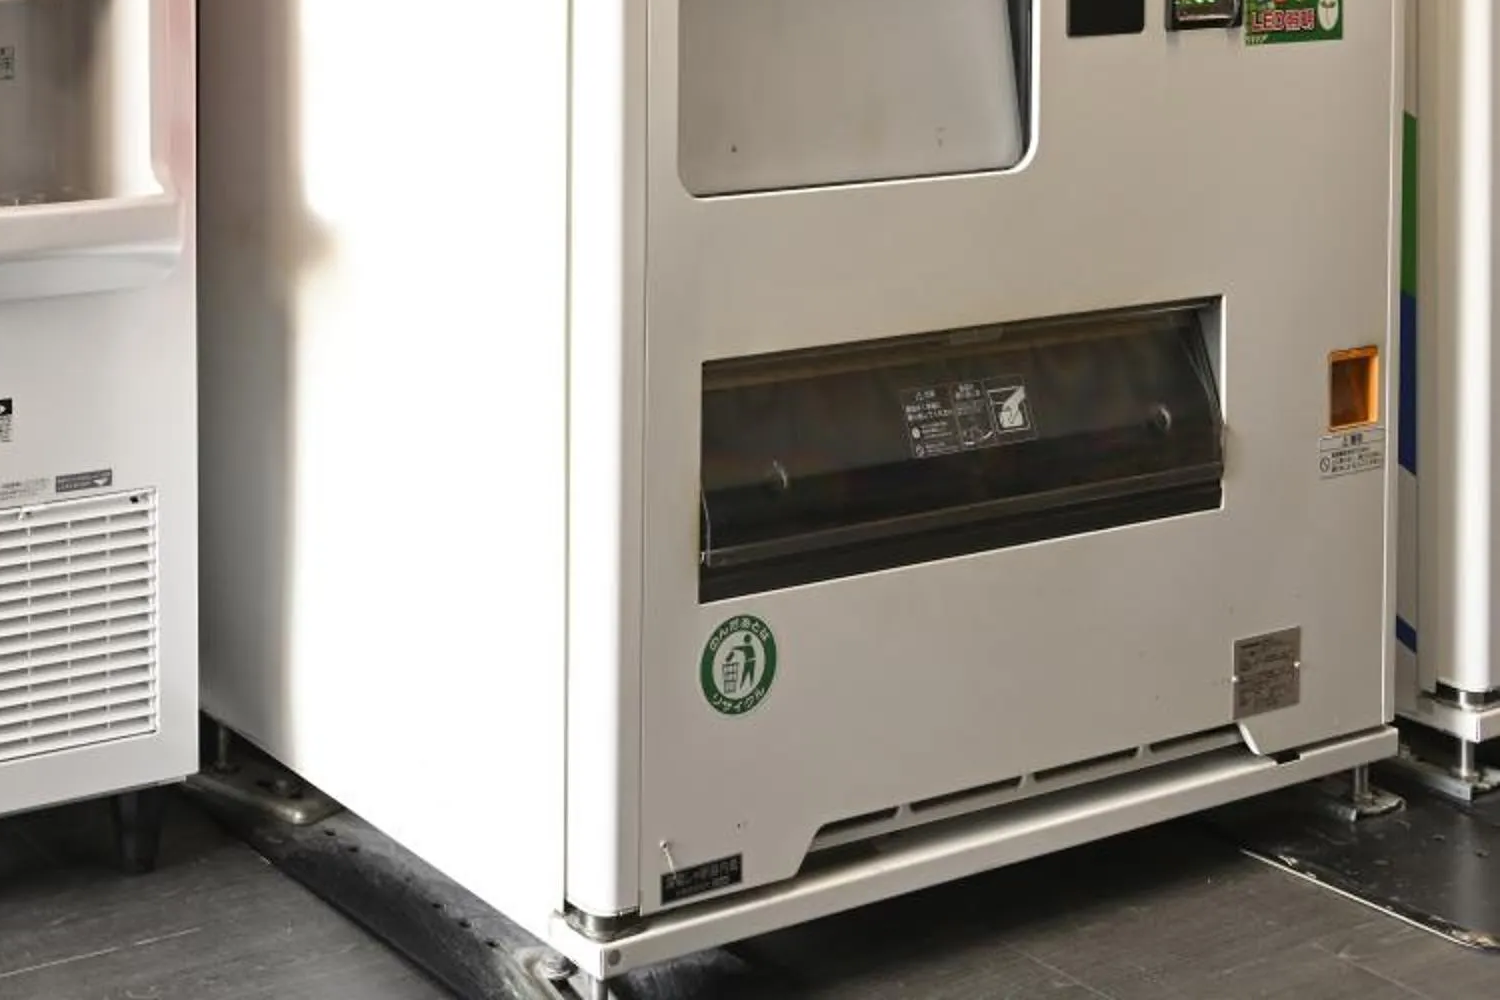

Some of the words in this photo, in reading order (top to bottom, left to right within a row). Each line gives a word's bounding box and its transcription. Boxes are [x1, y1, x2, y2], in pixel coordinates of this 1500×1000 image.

[713, 687, 766, 712] リサイクル
